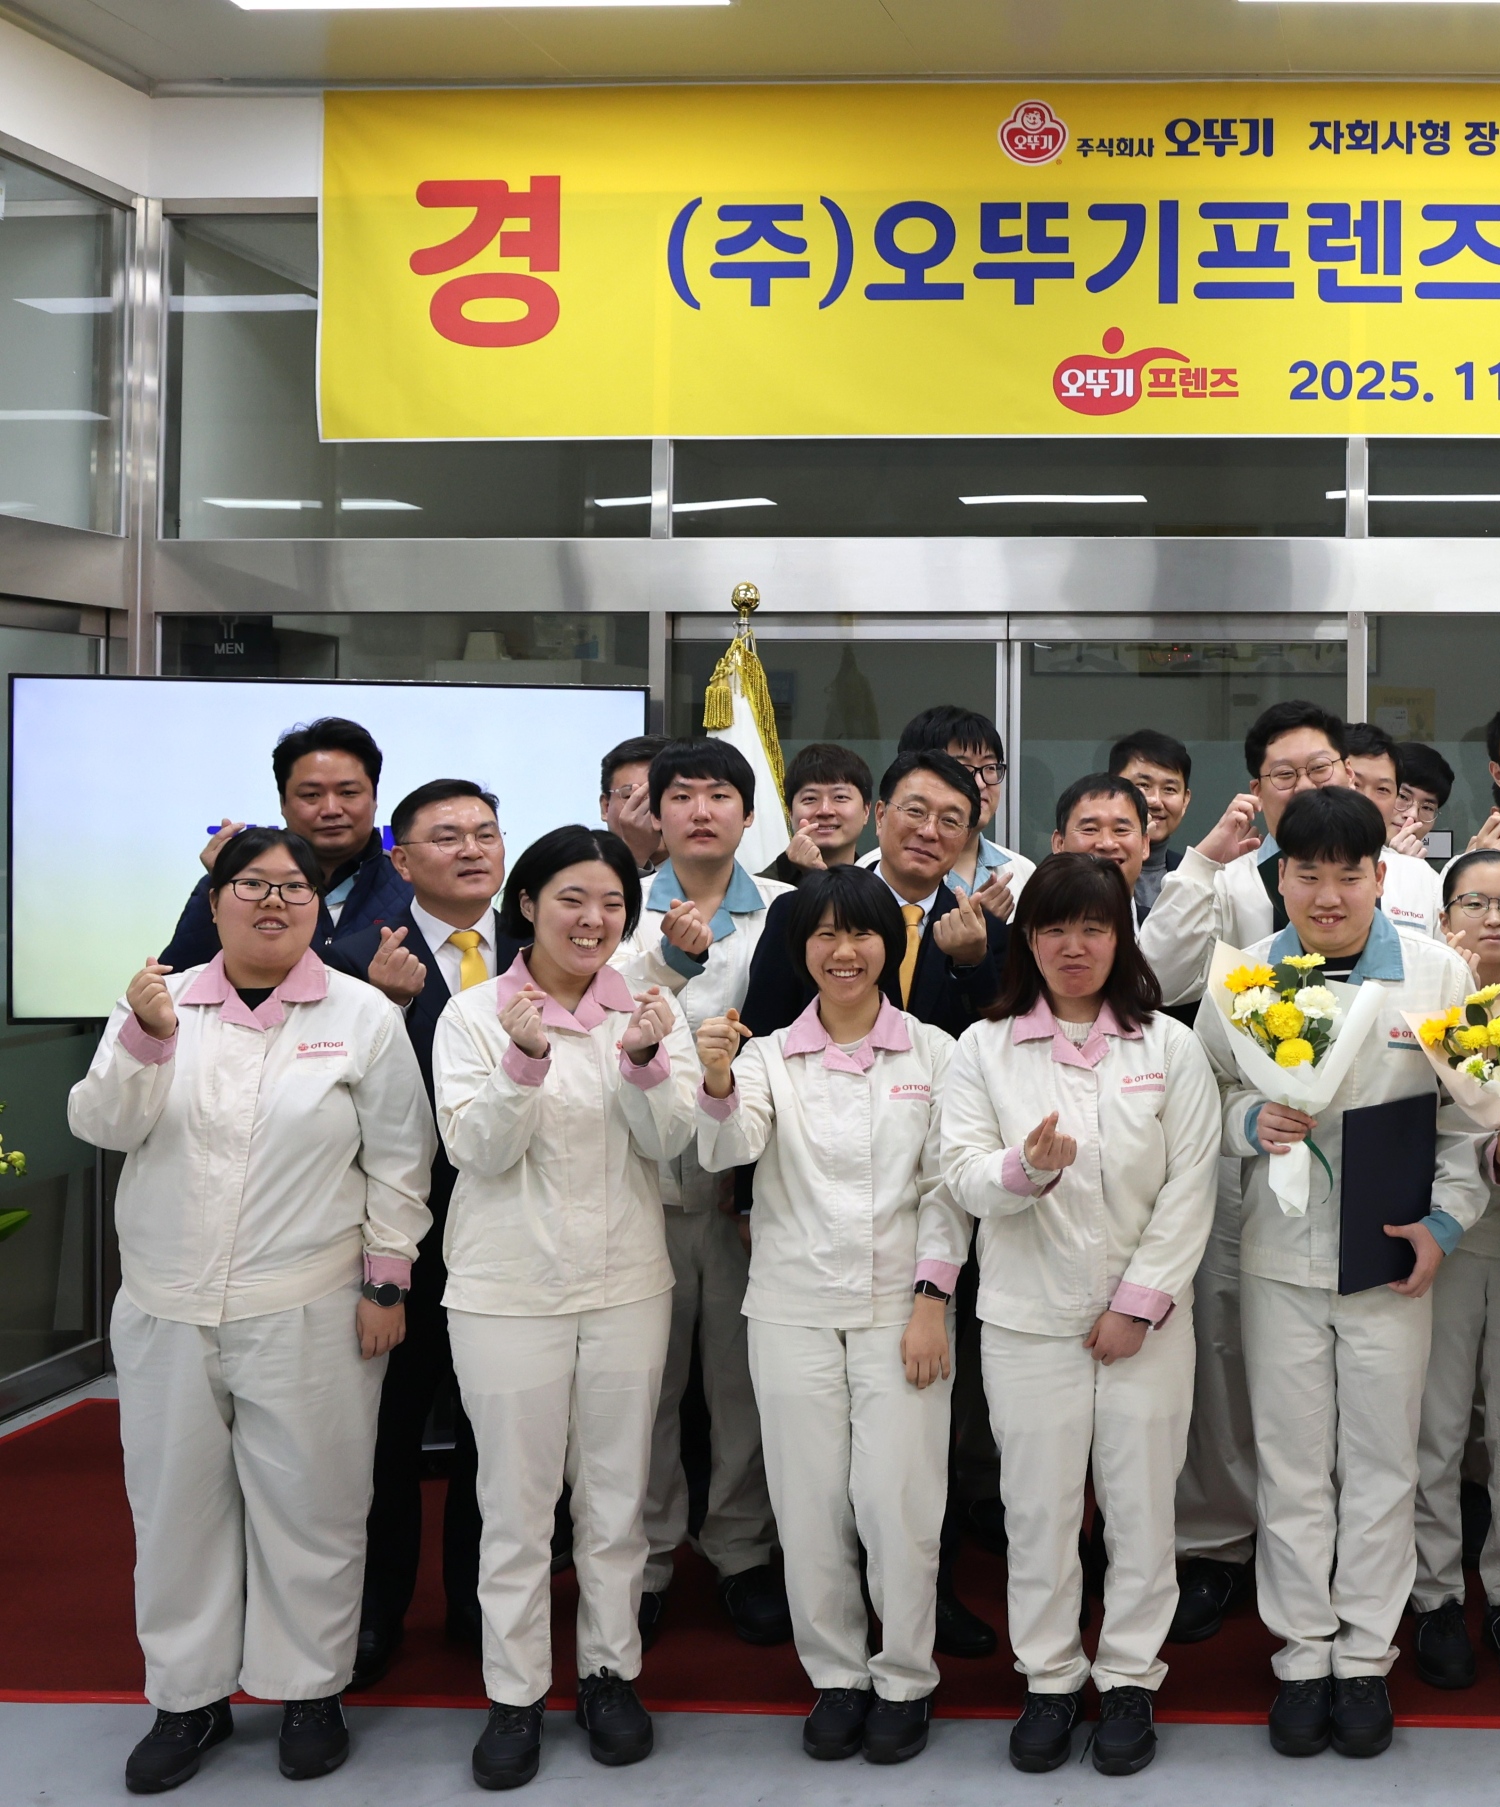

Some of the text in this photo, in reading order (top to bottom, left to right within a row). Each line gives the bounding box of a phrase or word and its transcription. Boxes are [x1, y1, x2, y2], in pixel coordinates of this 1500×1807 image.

[1013, 134, 1053, 150] 오뚜기
[1077, 138, 1154, 157] 주식회사
[1165, 118, 1273, 157] 오뚜기
[1310, 121, 1450, 155] 자회사형
[411, 176, 560, 347] 경
[1060, 367, 1240, 398] 오뚜기 프렌즈
[1289, 360, 1434, 402] 2025.
[214, 642, 244, 654] MEN
[310, 1041, 344, 1049] OTTOGI
[1134, 1072, 1164, 1082] OTTOGI
[902, 1084, 931, 1093] OTTOGI
